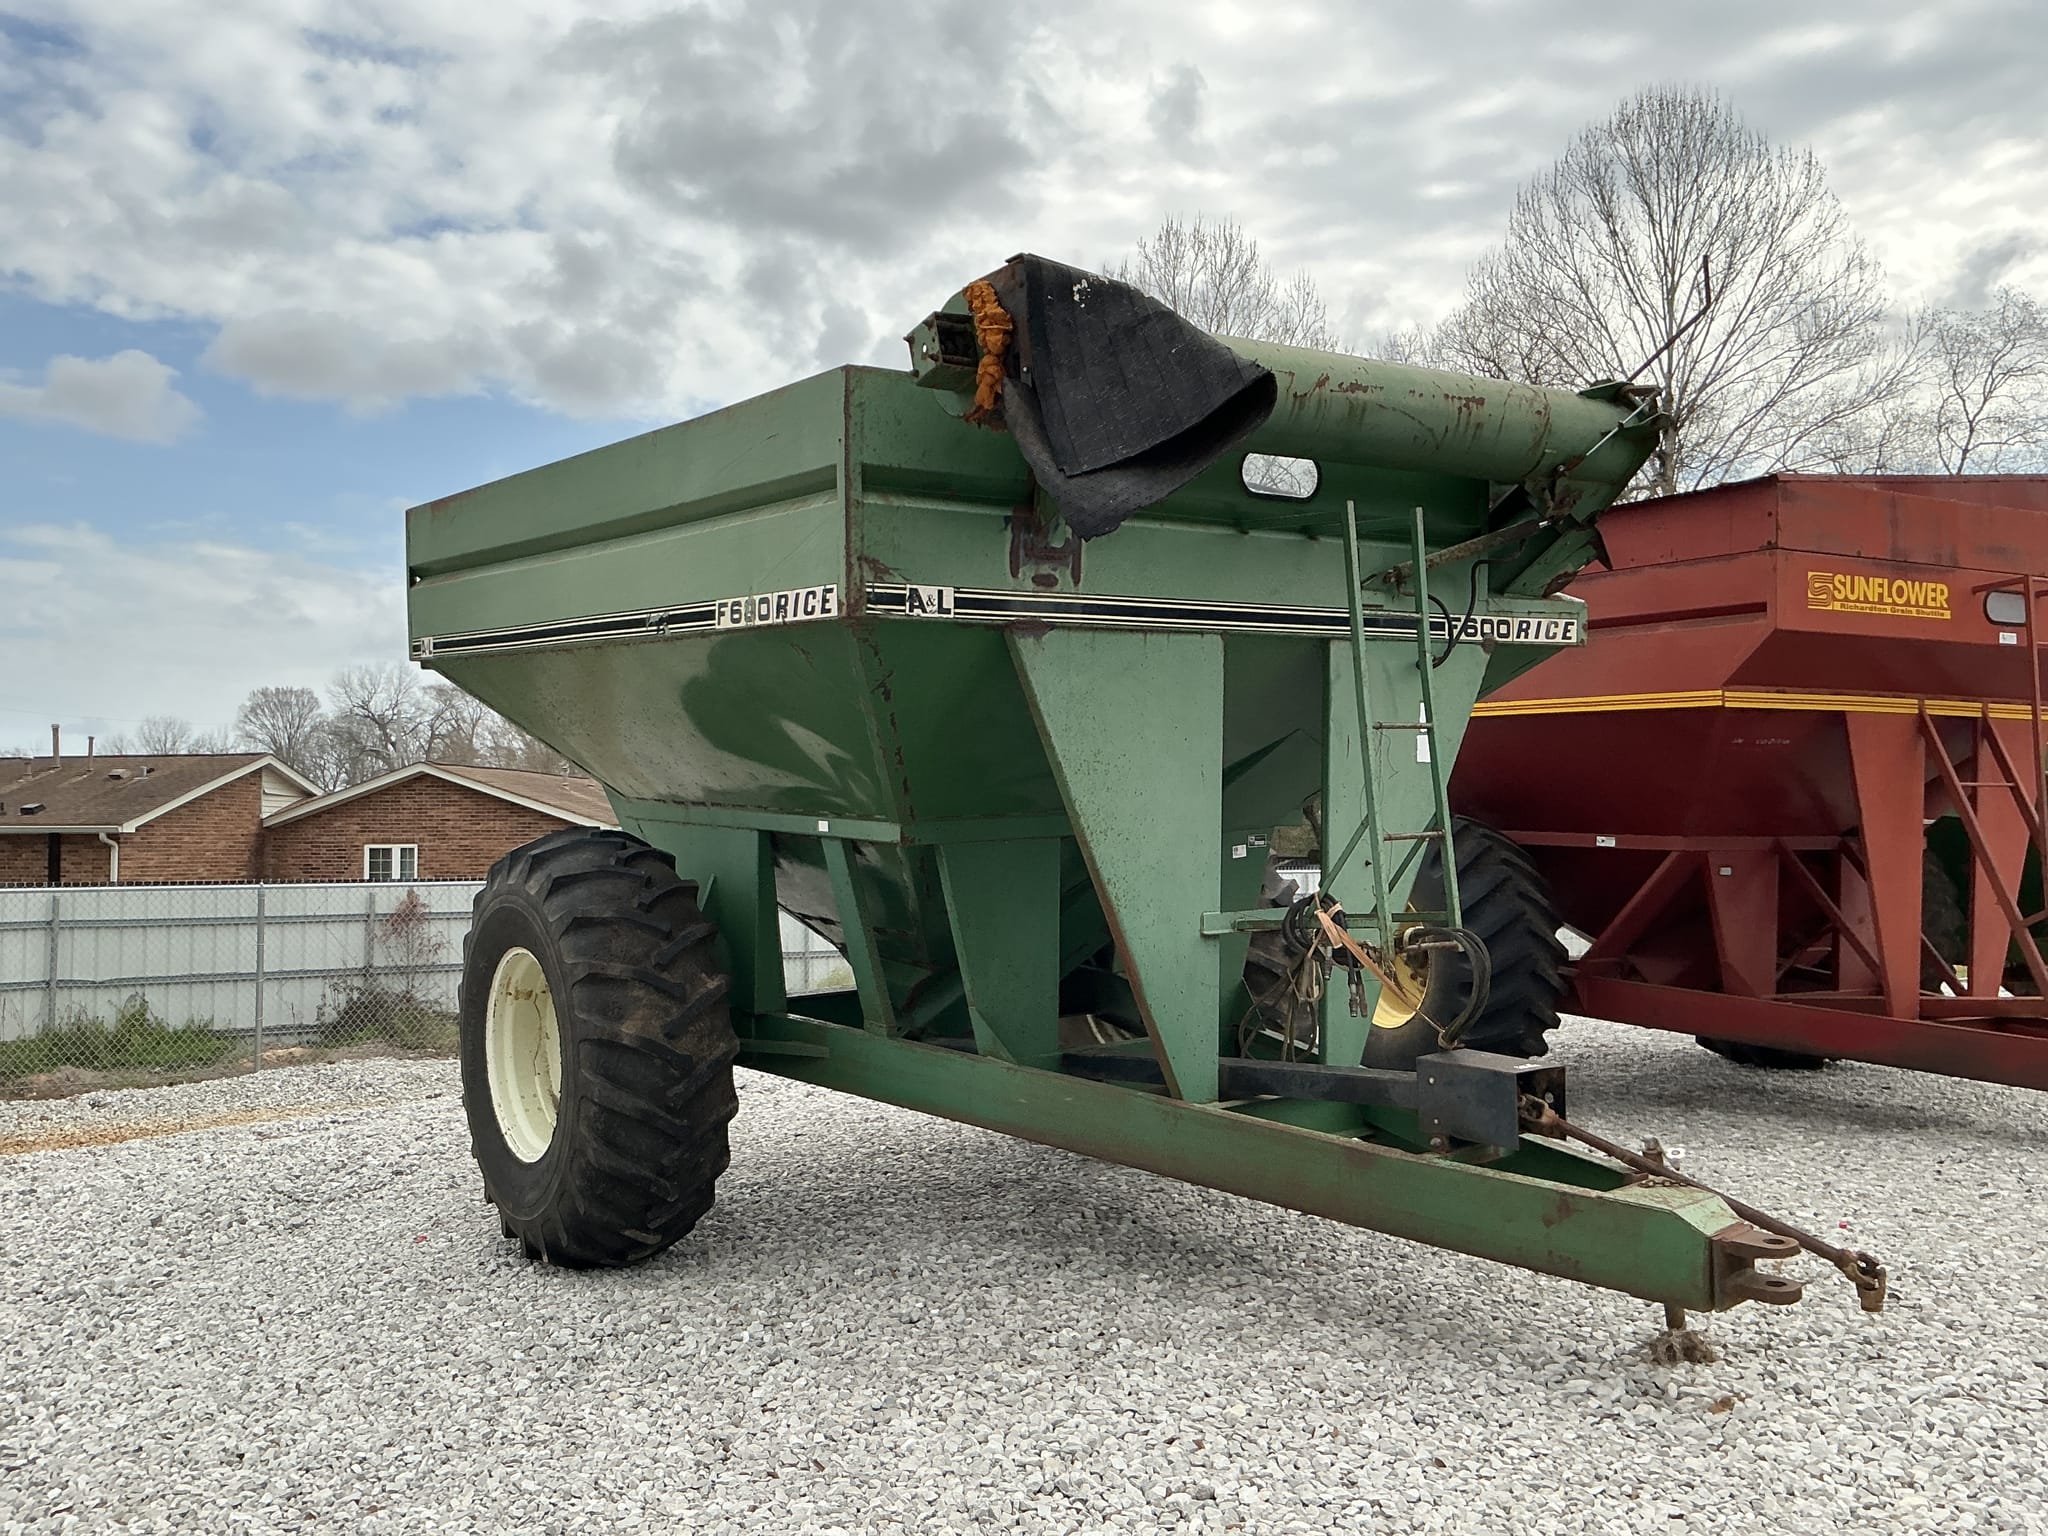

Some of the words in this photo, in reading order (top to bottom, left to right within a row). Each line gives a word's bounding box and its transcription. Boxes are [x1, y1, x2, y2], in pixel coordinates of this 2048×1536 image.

[908, 587, 952, 614] A&L
[1833, 574, 1949, 608] SUNFLOWER
[1890, 606, 1913, 616] Grain
[1915, 608, 1945, 617] Shuttle
[1515, 619, 1575, 640] RICE
